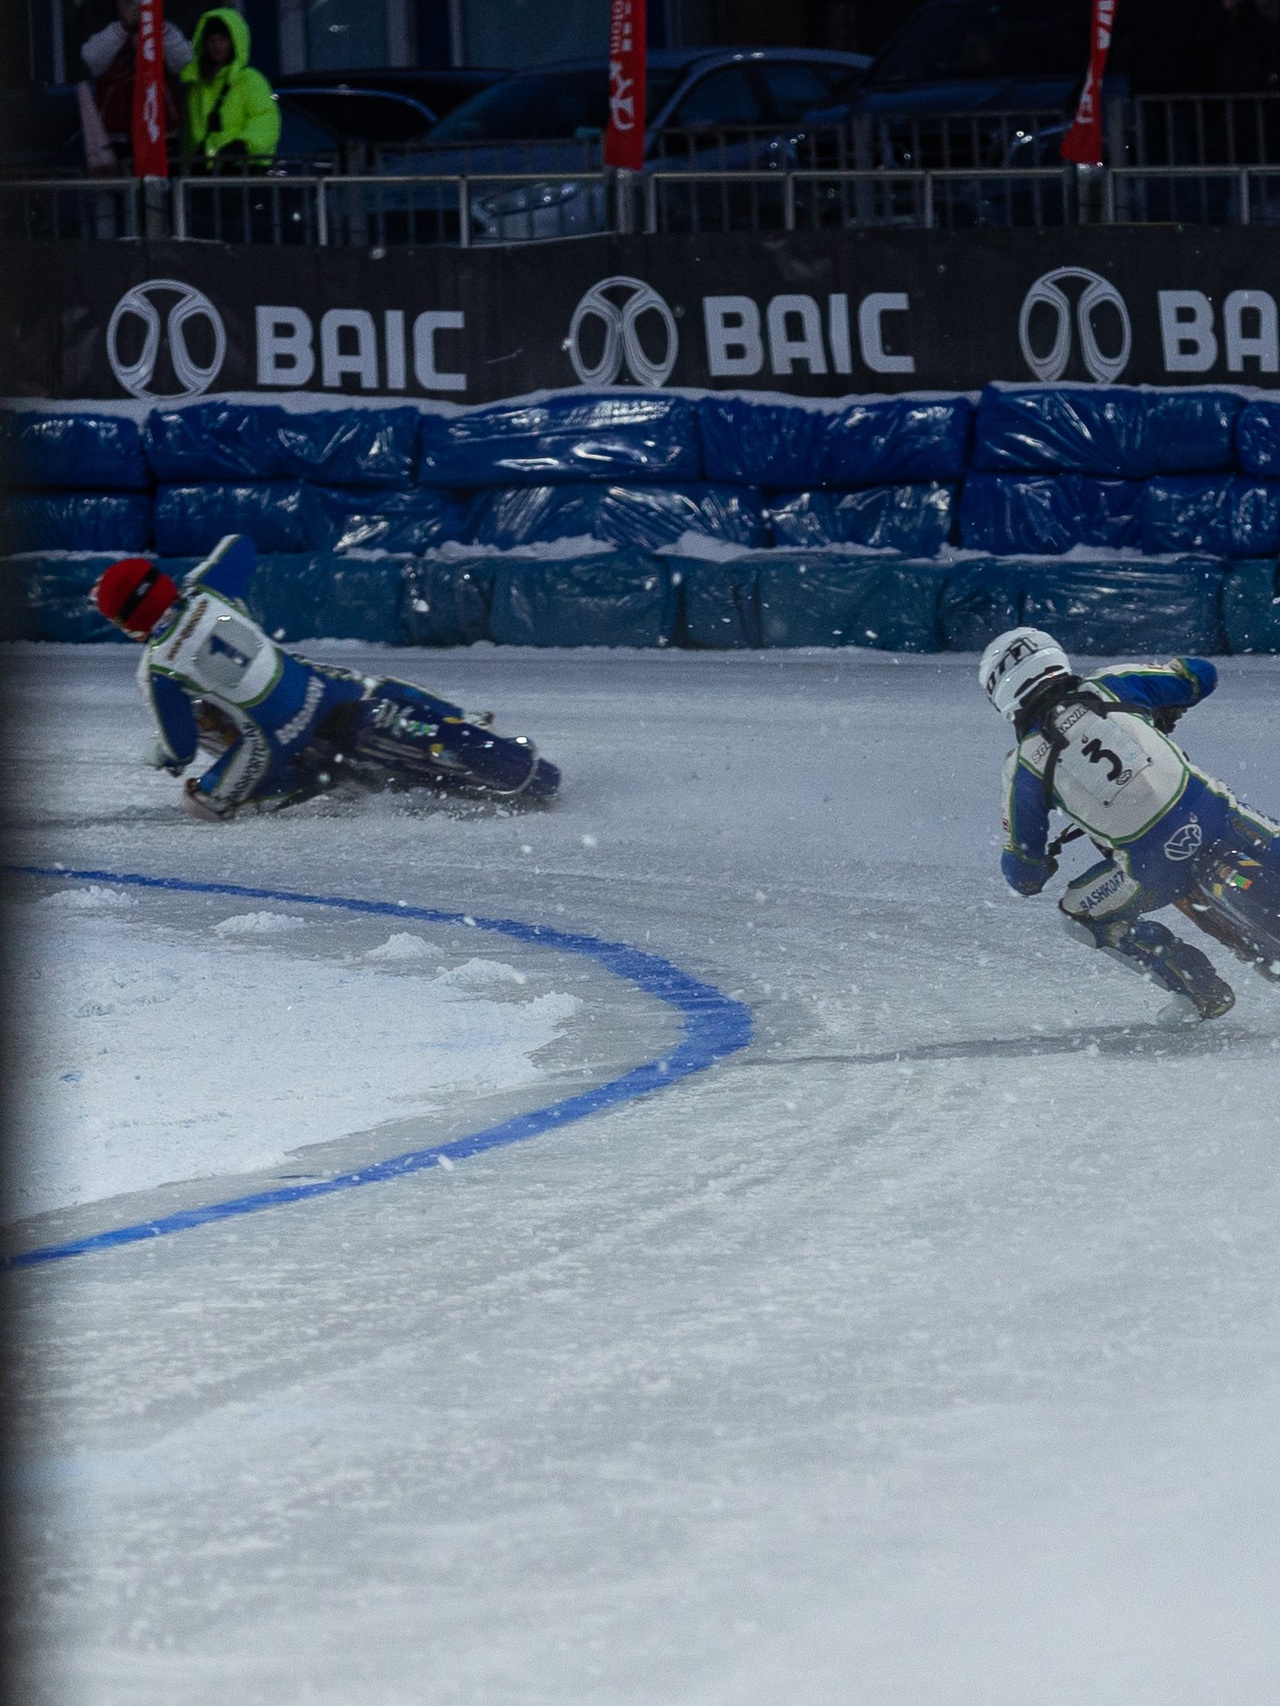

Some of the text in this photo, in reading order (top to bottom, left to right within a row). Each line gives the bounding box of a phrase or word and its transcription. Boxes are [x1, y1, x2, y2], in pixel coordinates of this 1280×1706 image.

[257, 306, 466, 390] BAIC
[704, 293, 914, 375] BAIC
[208, 634, 252, 668] 1
[1081, 738, 1123, 782] 3
